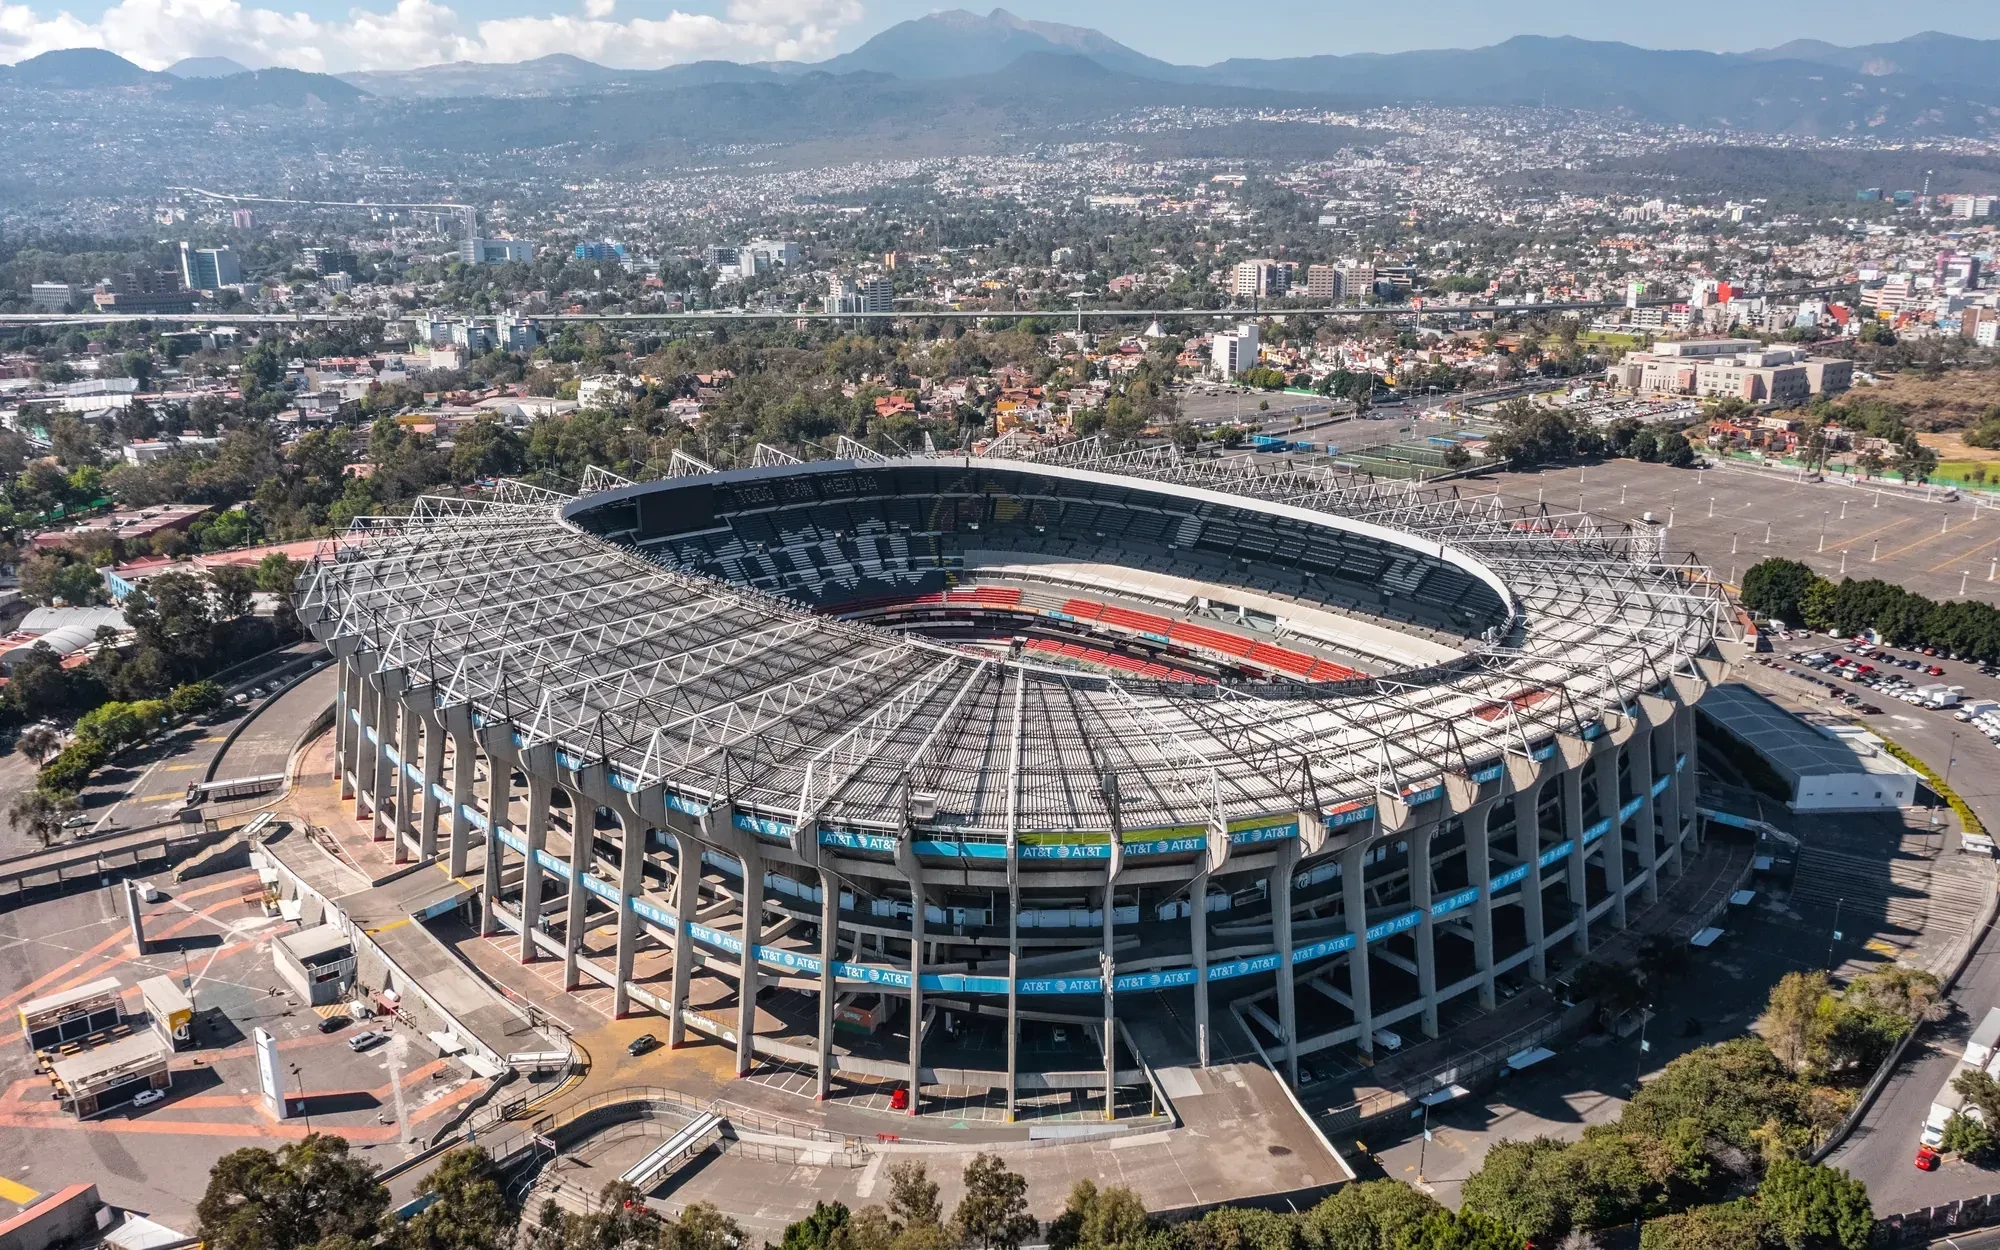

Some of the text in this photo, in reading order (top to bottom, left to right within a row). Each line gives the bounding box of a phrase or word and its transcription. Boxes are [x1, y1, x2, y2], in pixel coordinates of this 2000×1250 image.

[1479, 769, 1497, 782] AT&T
[1416, 788, 1437, 802] AT&T
[1346, 809, 1368, 823] AT&T
[825, 833, 852, 846] AT&T
[1264, 826, 1291, 839] AT&T
[1023, 846, 1102, 857] AT&T AT&T
[1124, 838, 1200, 855] AT&T AT&T
[1457, 890, 1475, 904] AT&T
[633, 902, 650, 915] AT&T
[691, 926, 711, 940] AT&T
[1366, 914, 1416, 940] AT&T AT&T
[1292, 937, 1350, 962] AT&T AT&T
[758, 950, 820, 970] AT&T AT&T
[1209, 957, 1276, 978] AT&T AT&T
[839, 965, 908, 985] AT&T AT&T
[1118, 972, 1191, 989] AT&T AT&T
[1022, 980, 1098, 992] AT&T AT&T
